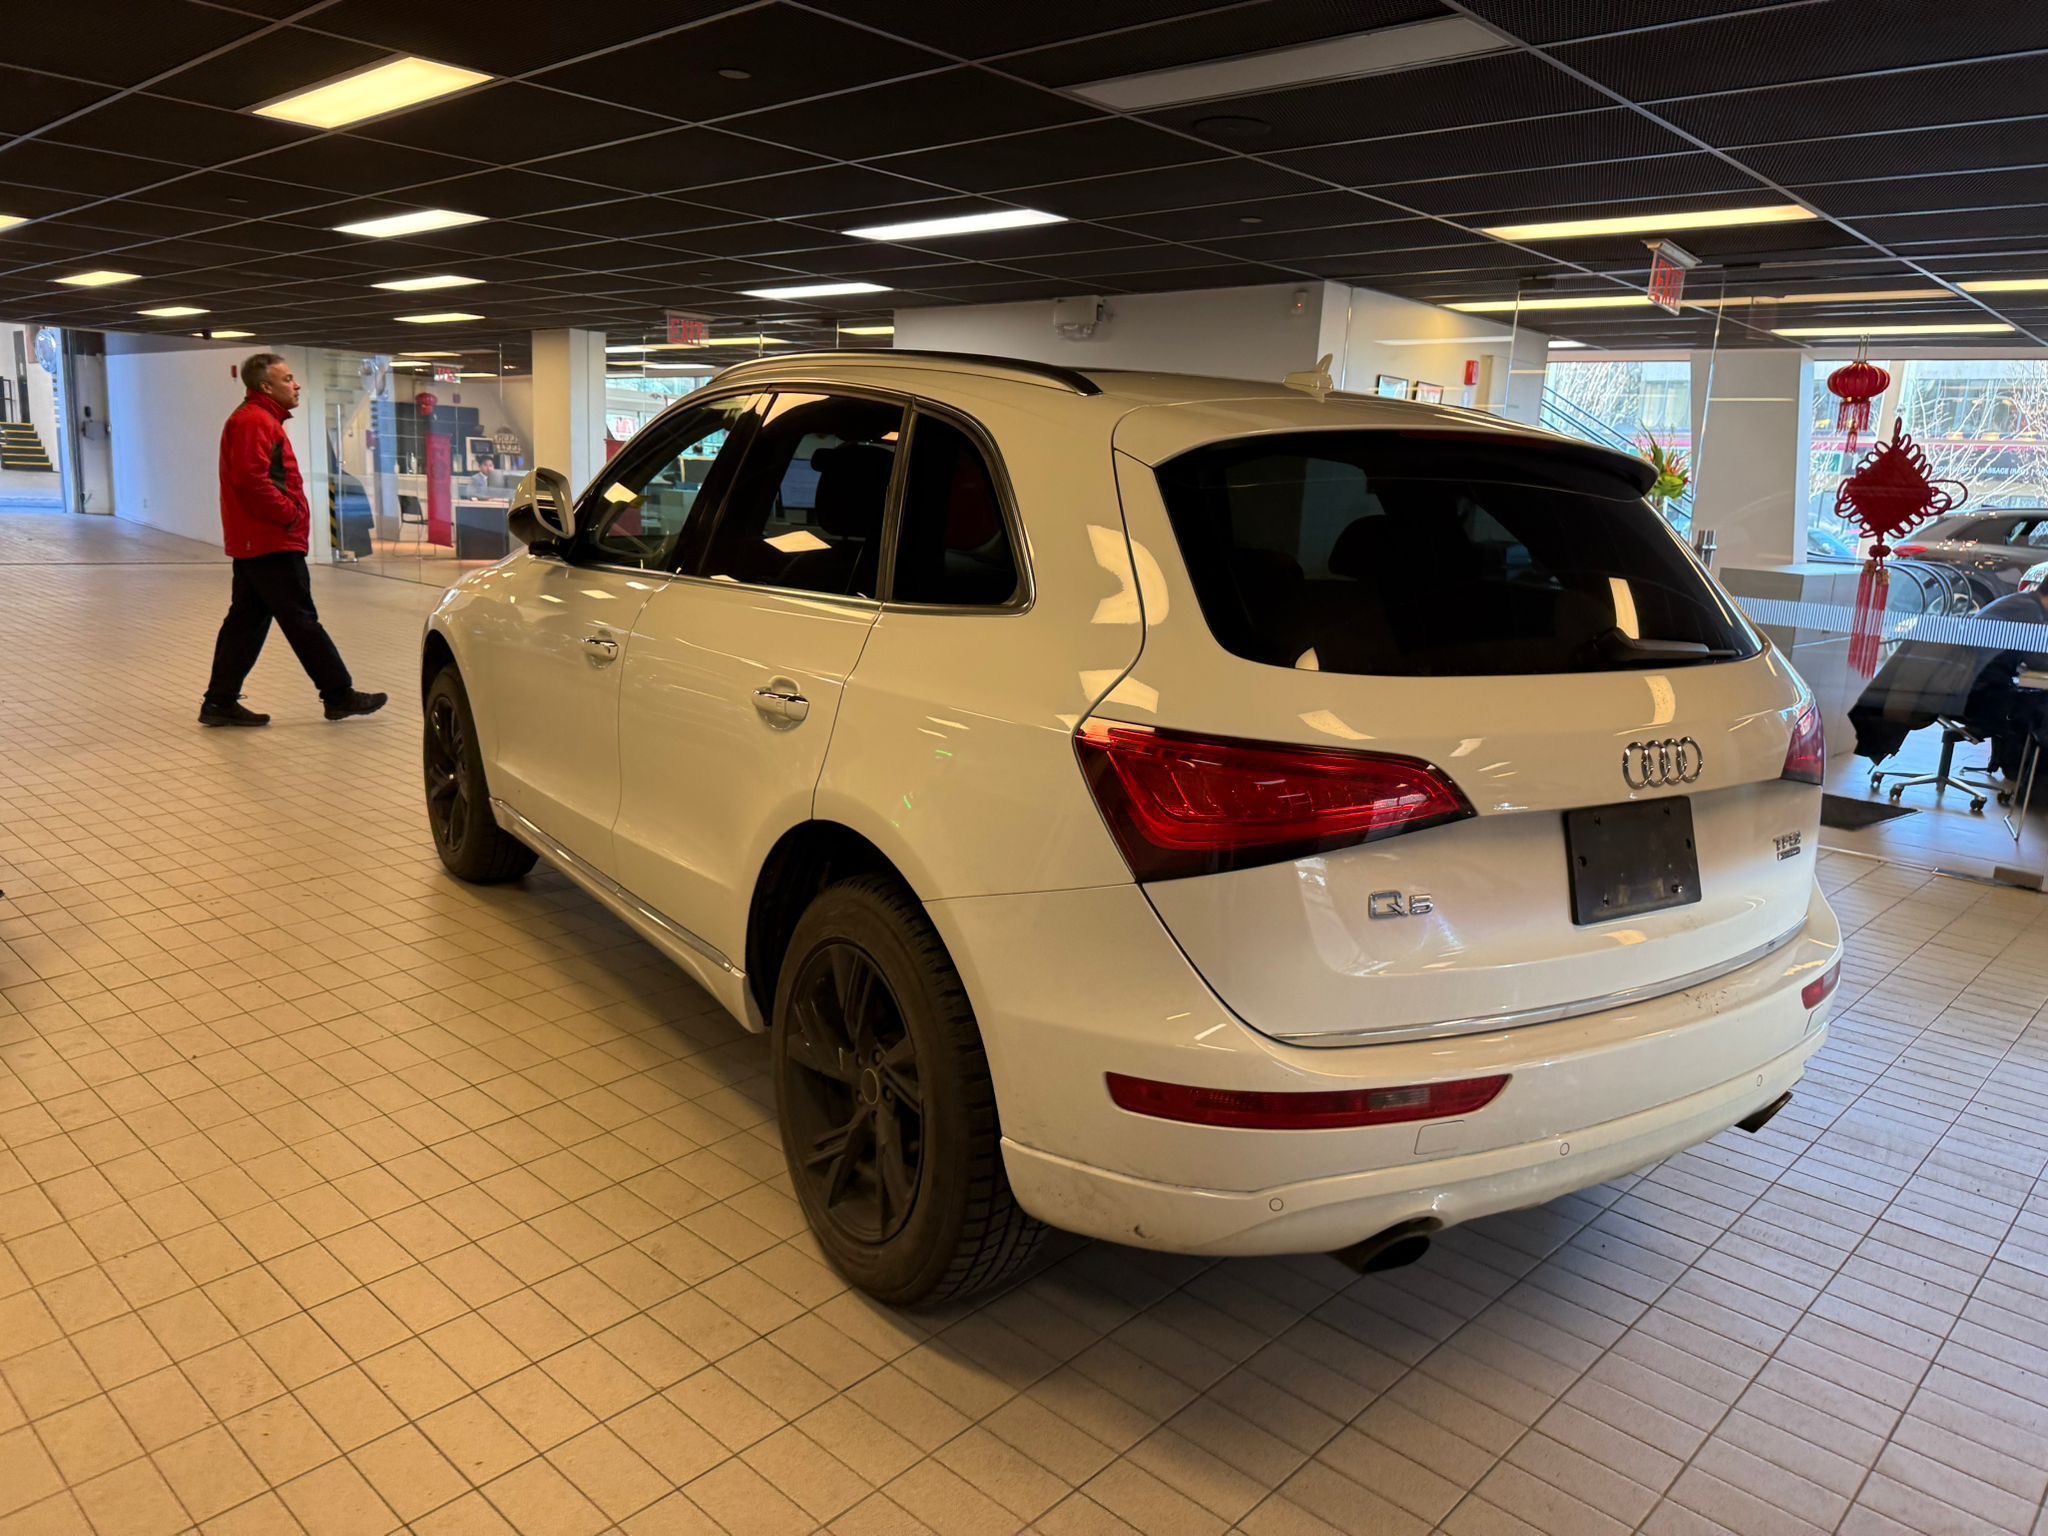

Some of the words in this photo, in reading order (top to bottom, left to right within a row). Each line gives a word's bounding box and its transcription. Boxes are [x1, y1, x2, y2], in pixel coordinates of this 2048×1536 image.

[1653, 258, 1684, 308] EXIT
[671, 319, 705, 346] EXIT
[1368, 890, 1434, 920] Q5
